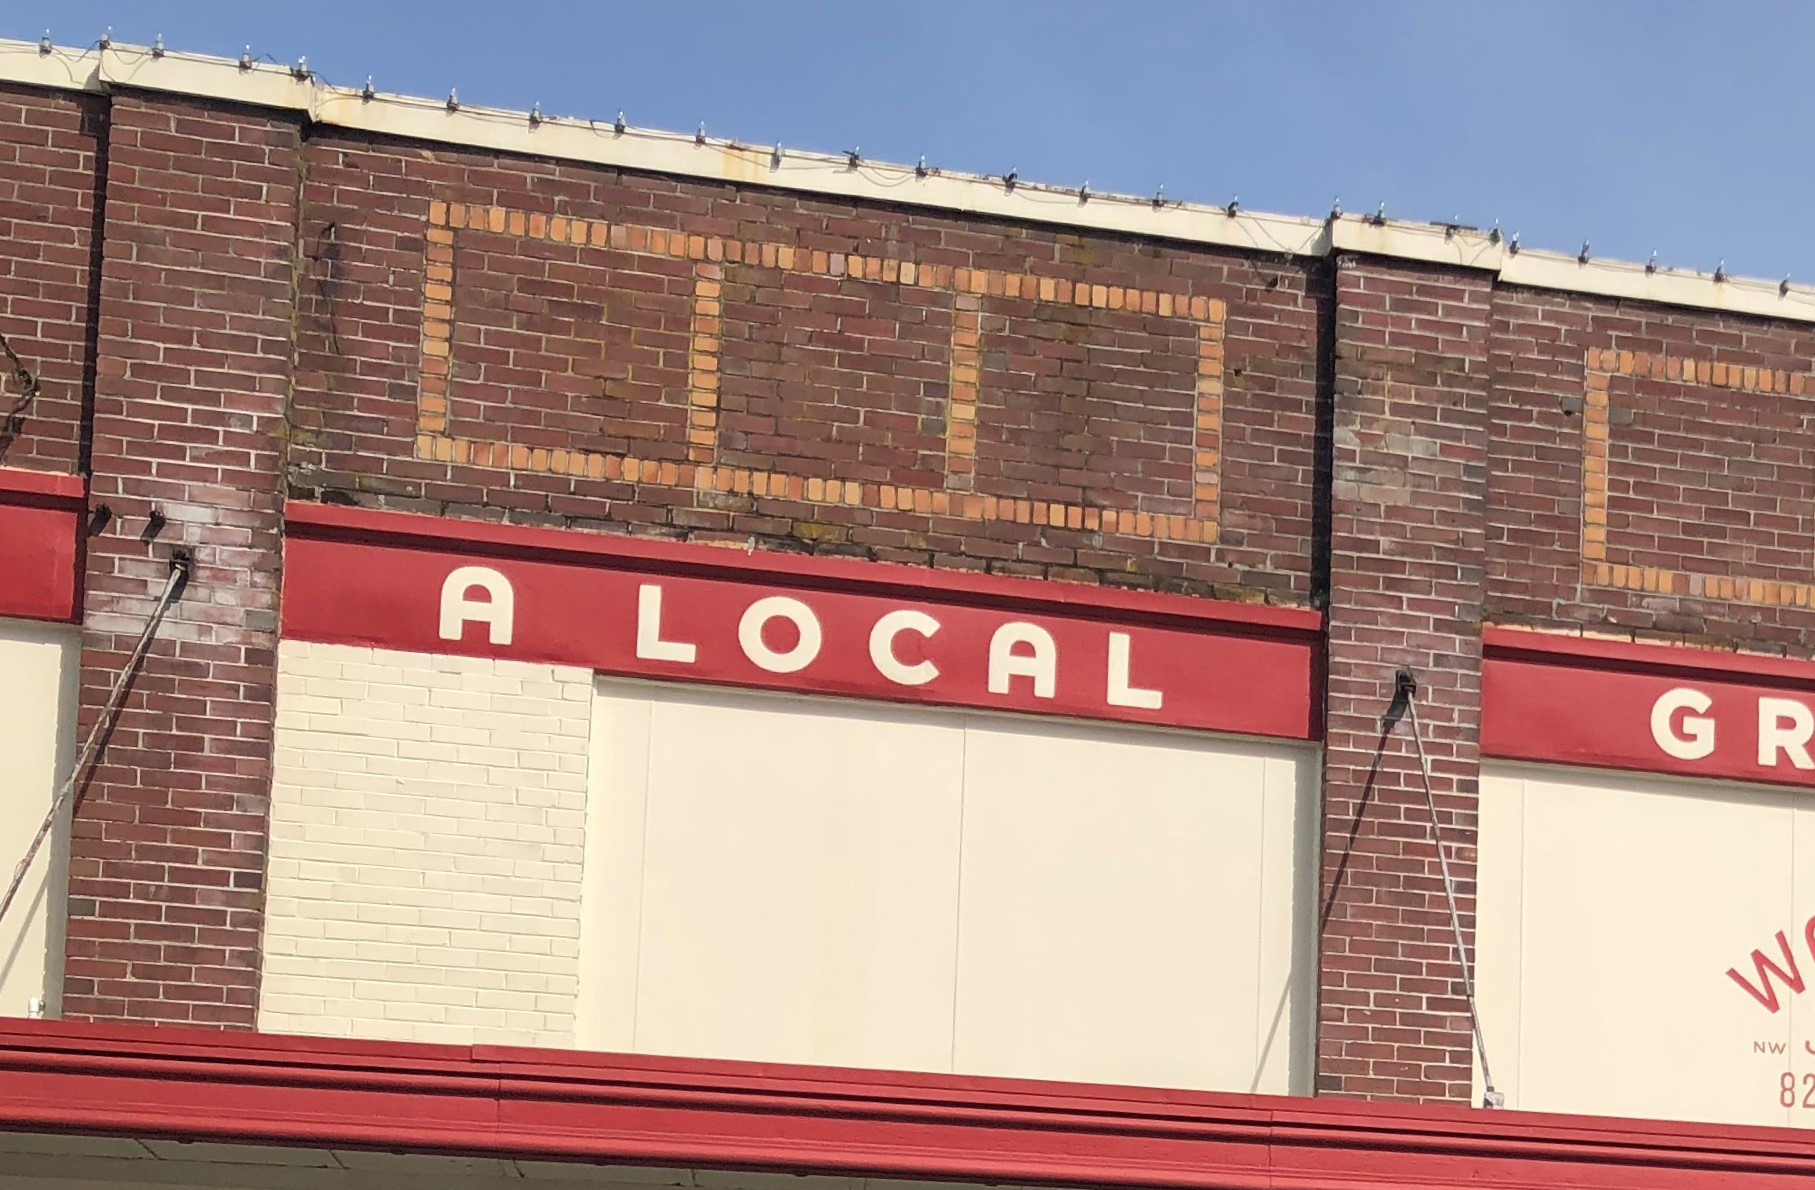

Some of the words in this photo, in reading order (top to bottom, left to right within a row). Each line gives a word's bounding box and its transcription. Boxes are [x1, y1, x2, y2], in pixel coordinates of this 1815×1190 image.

[439, 566, 514, 645] A
[636, 584, 1163, 710] LOCAL
[1753, 1040, 1786, 1055] NW
